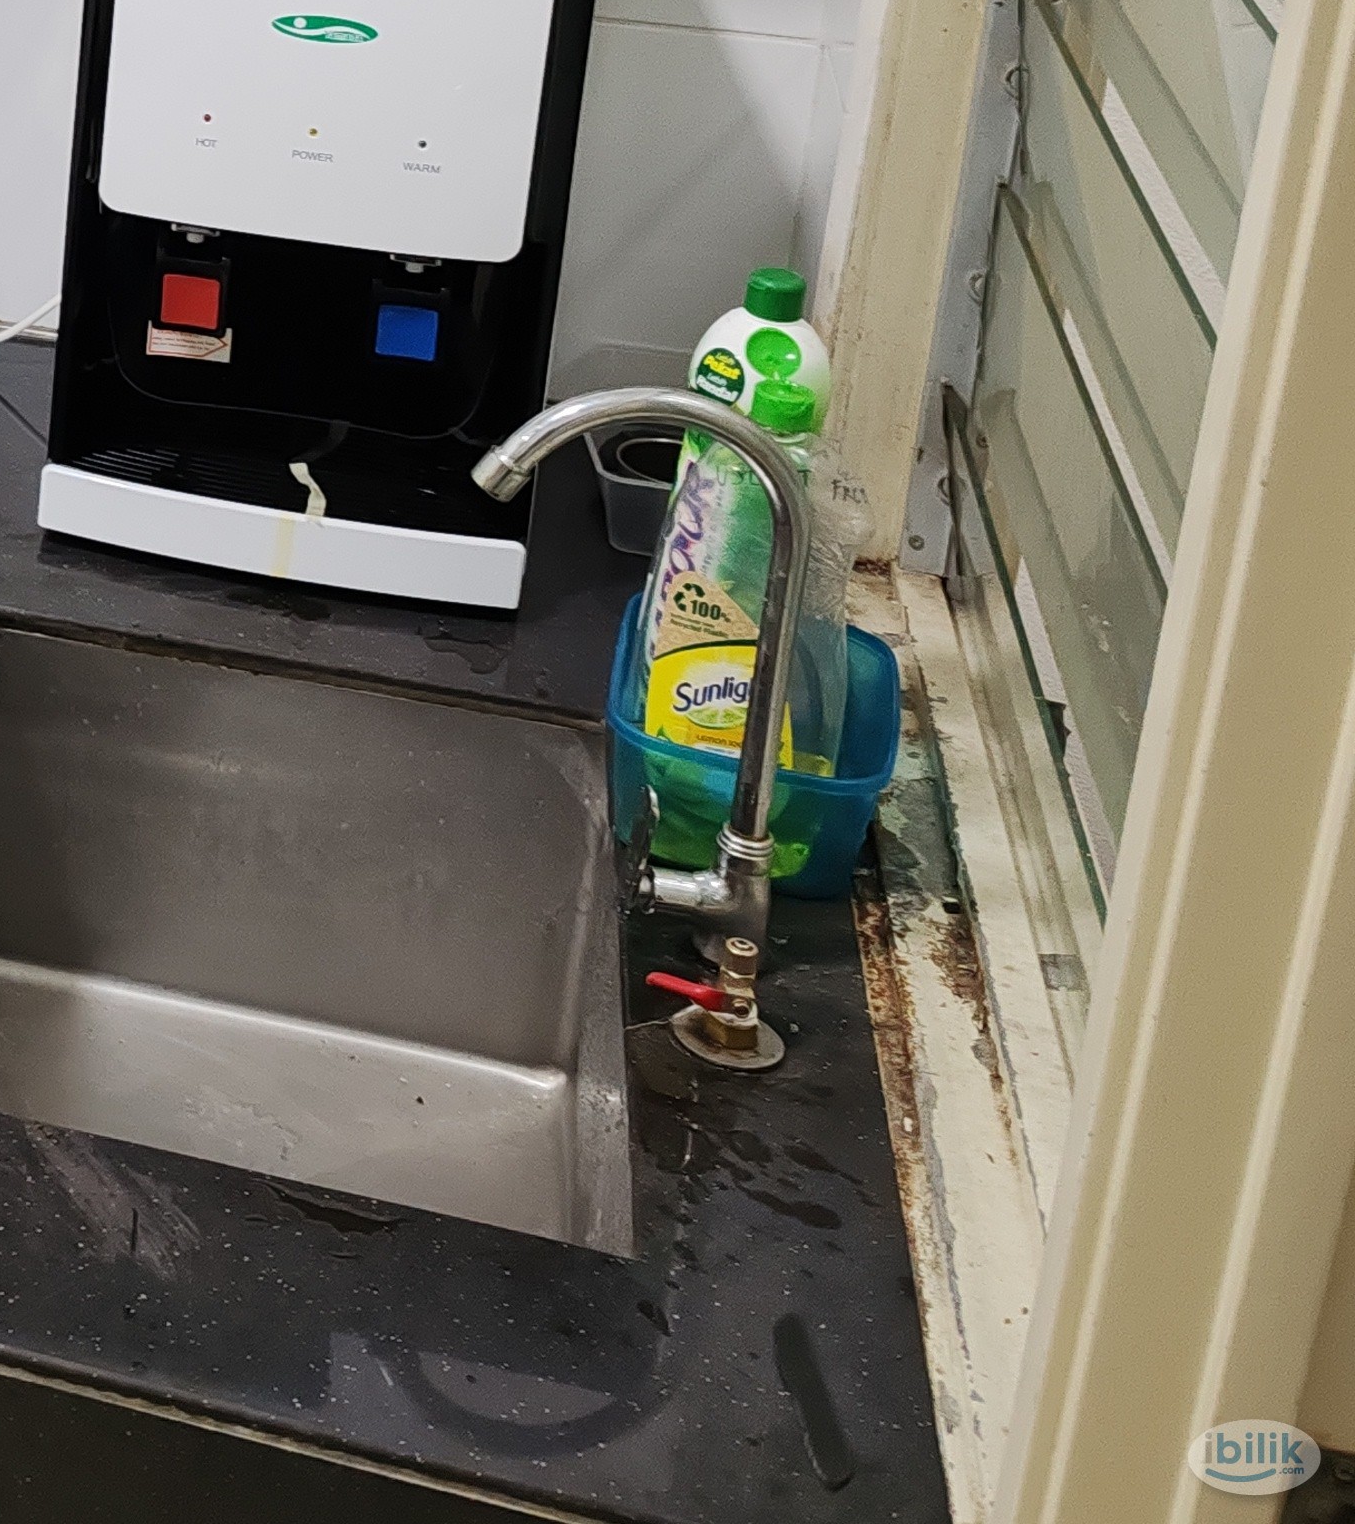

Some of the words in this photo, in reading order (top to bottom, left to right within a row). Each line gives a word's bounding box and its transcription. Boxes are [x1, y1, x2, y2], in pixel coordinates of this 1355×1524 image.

[195, 137, 218, 149] HOT
[291, 149, 334, 163] POWER
[402, 162, 441, 174] WARM
[690, 599, 731, 624] 100%
[672, 676, 751, 713] Sunlig
